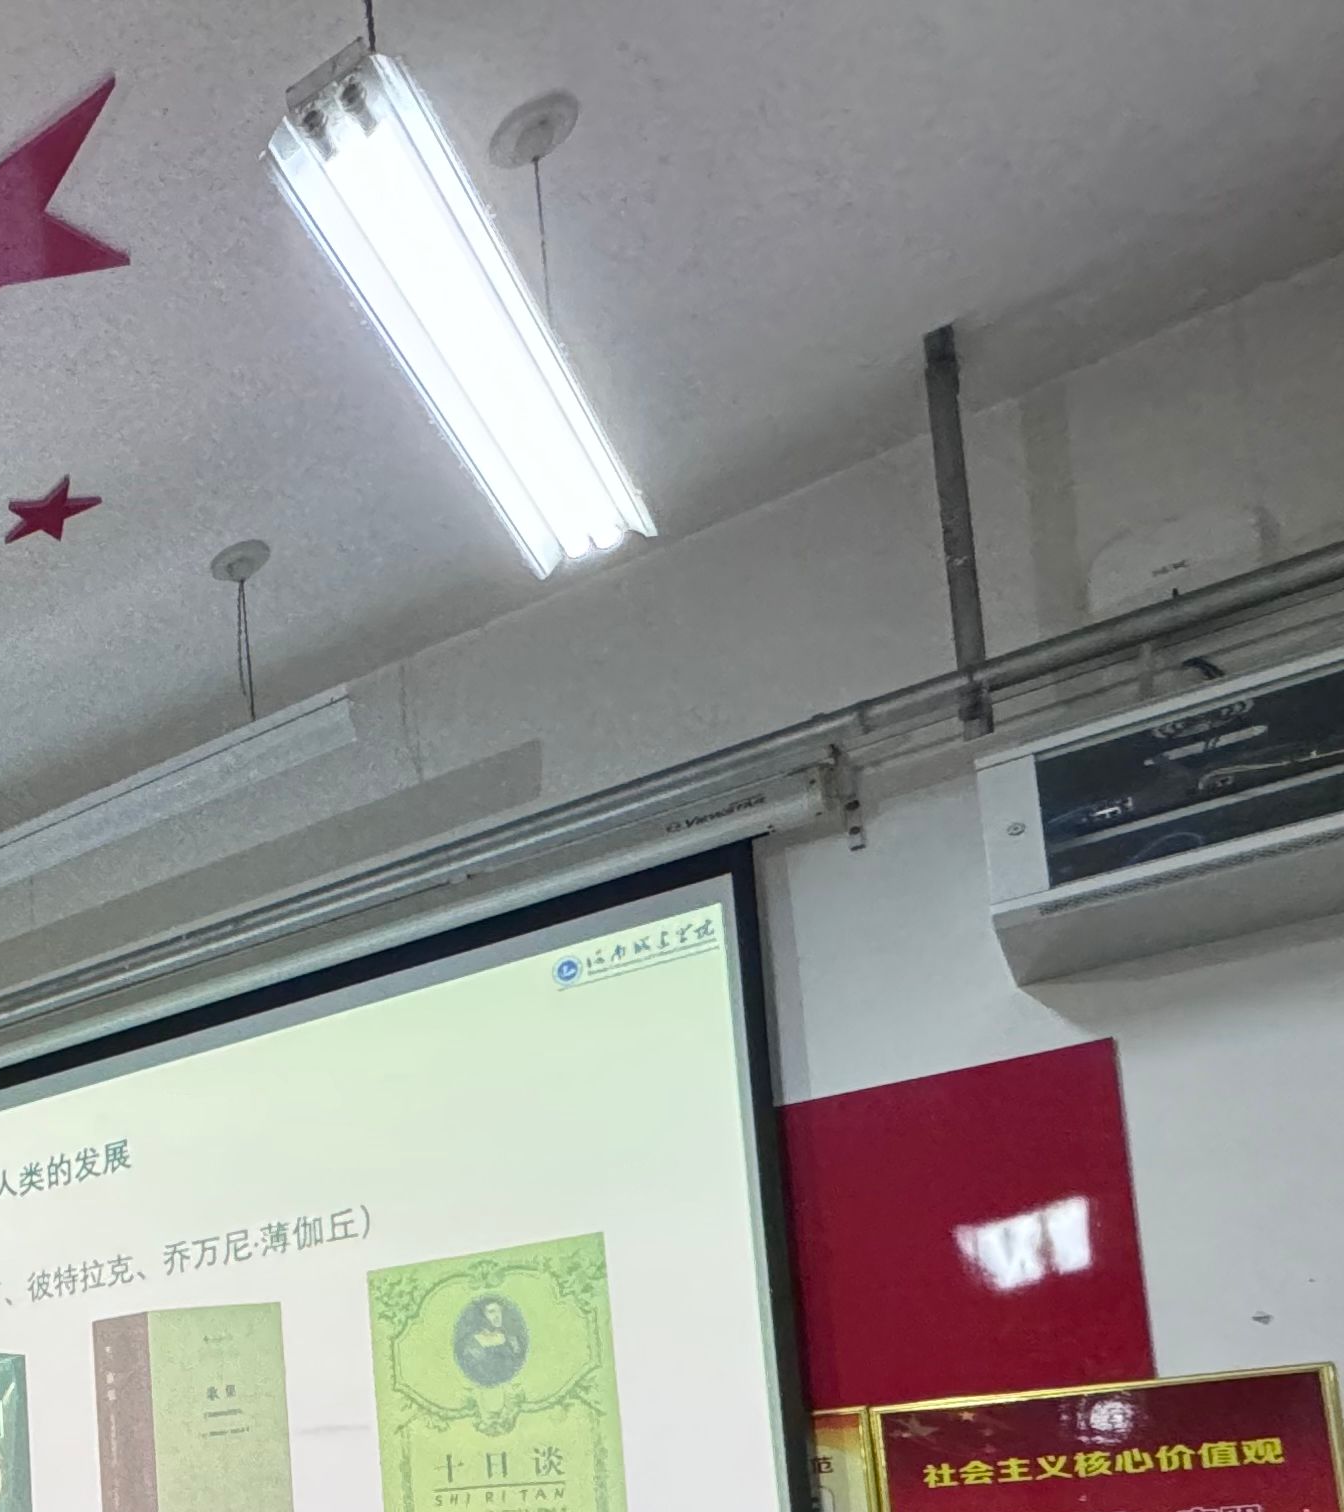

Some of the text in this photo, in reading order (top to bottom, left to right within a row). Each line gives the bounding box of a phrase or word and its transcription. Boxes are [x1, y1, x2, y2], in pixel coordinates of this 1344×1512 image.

[433, 1446, 566, 1484] 十日谈
[923, 1437, 1285, 1488] 社会主义核心价值观
